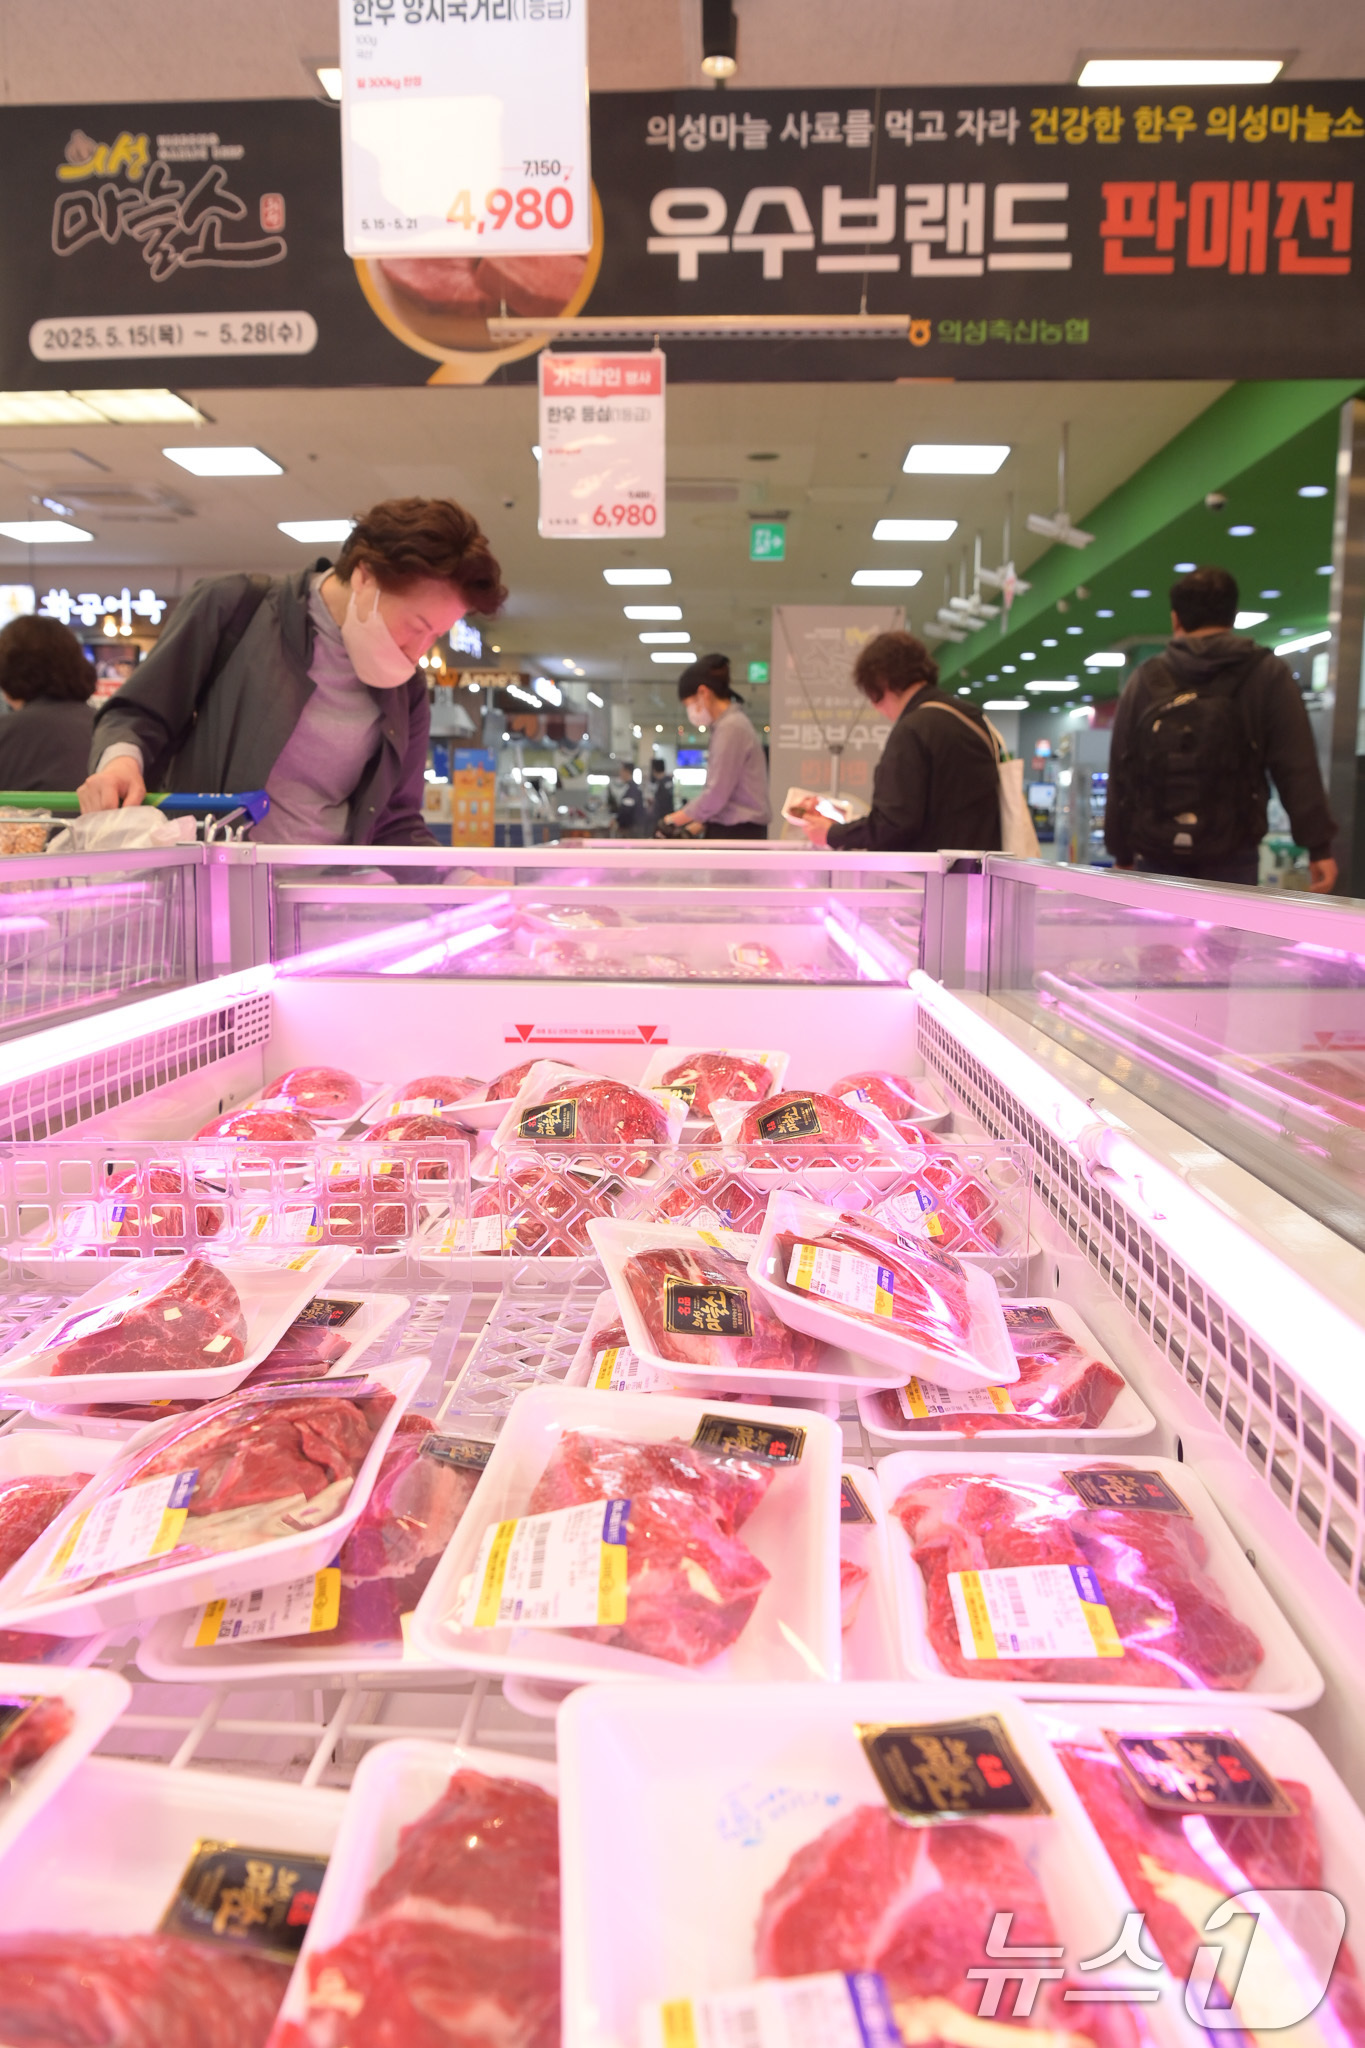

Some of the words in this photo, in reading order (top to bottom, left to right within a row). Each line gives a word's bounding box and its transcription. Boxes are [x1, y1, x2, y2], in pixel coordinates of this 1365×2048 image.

[354, 0, 395, 26] 한우
[646, 112, 771, 151] 의성마늘
[780, 110, 873, 148] 사료를
[885, 109, 947, 146] 먹고
[955, 108, 1020, 145] 자라
[1029, 107, 1124, 144] 건강한
[1134, 105, 1198, 143] 한우
[1205, 104, 1365, 143] 의성마늘소
[446, 187, 574, 234] 4,980
[647, 183, 1072, 281] 우수브랜드
[1099, 181, 1355, 275] 판매전
[593, 504, 657, 527] 6,980
